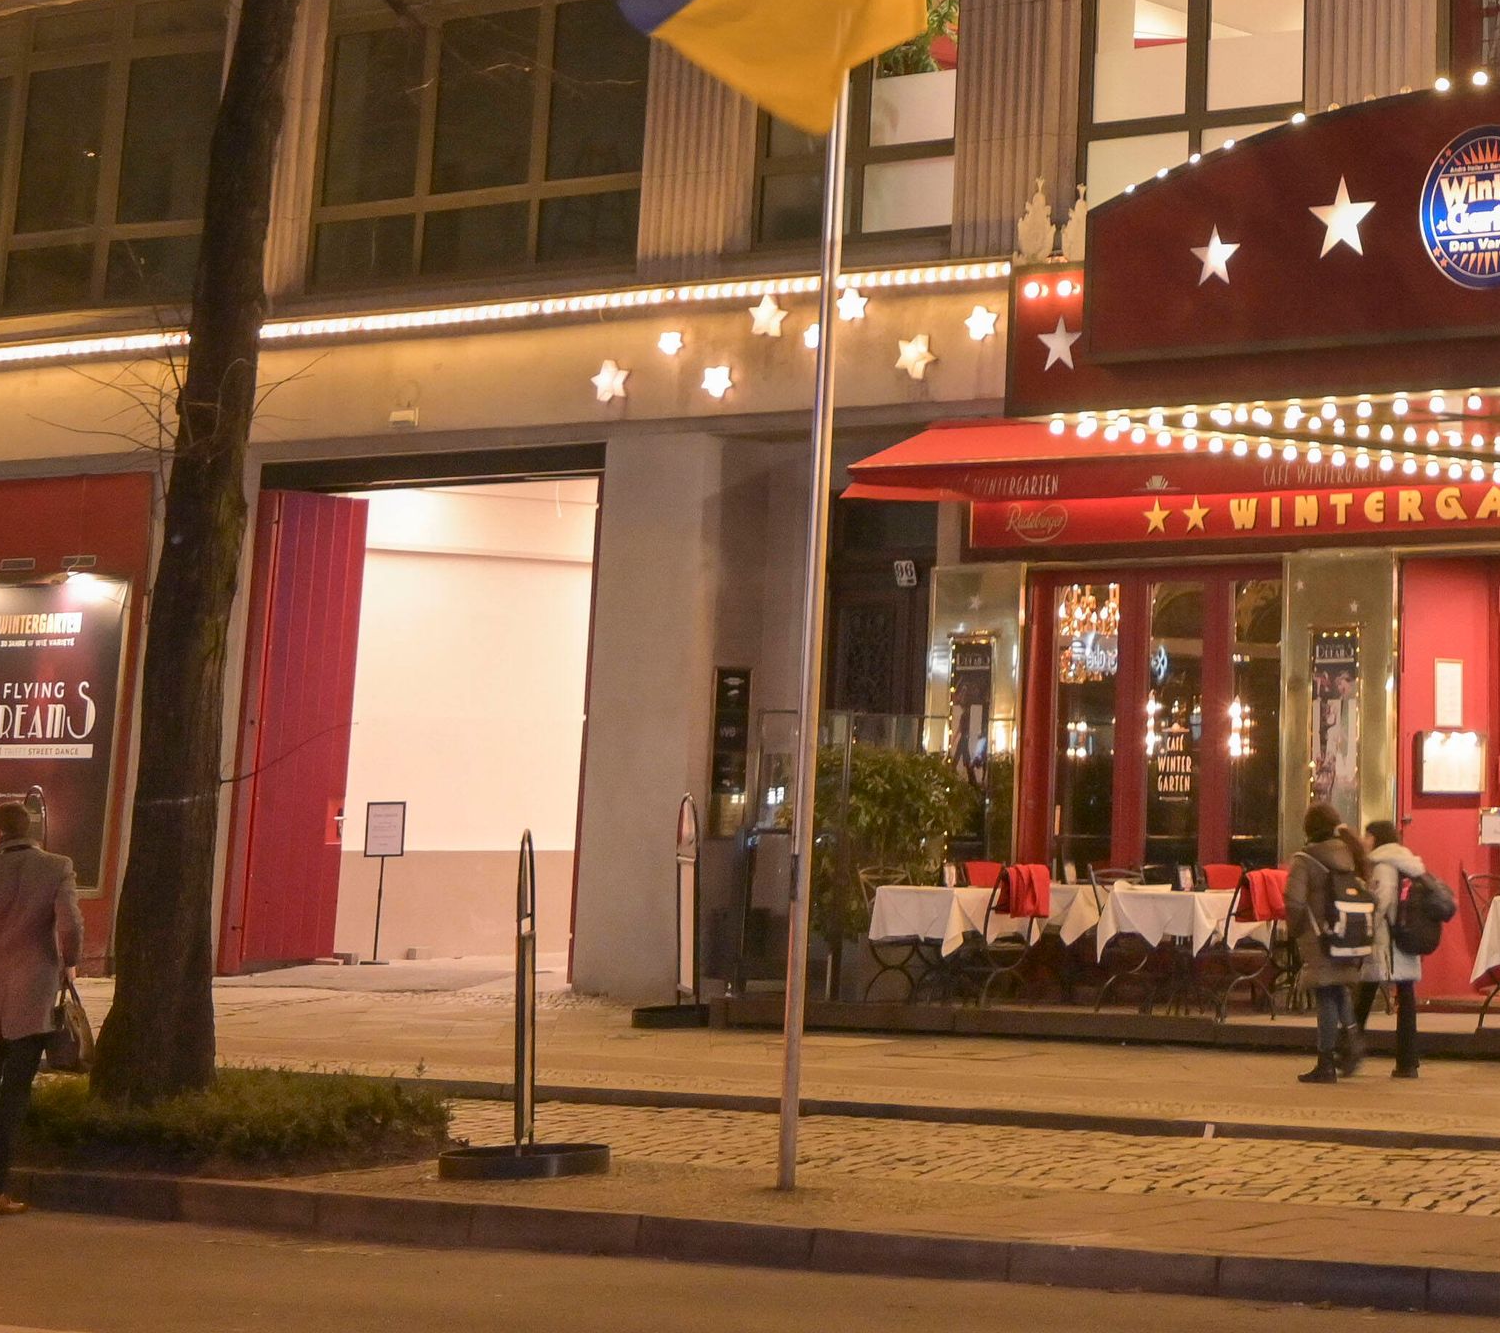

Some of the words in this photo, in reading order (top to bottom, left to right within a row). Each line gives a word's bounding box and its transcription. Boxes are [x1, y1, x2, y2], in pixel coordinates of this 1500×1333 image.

[1450, 240, 1474, 252] Das
[1297, 461, 1389, 484] WINTERGARTE
[2, 682, 66, 700] FLYING
[1157, 755, 1192, 773] WINTER
[1157, 774, 1191, 792] GARTEN
